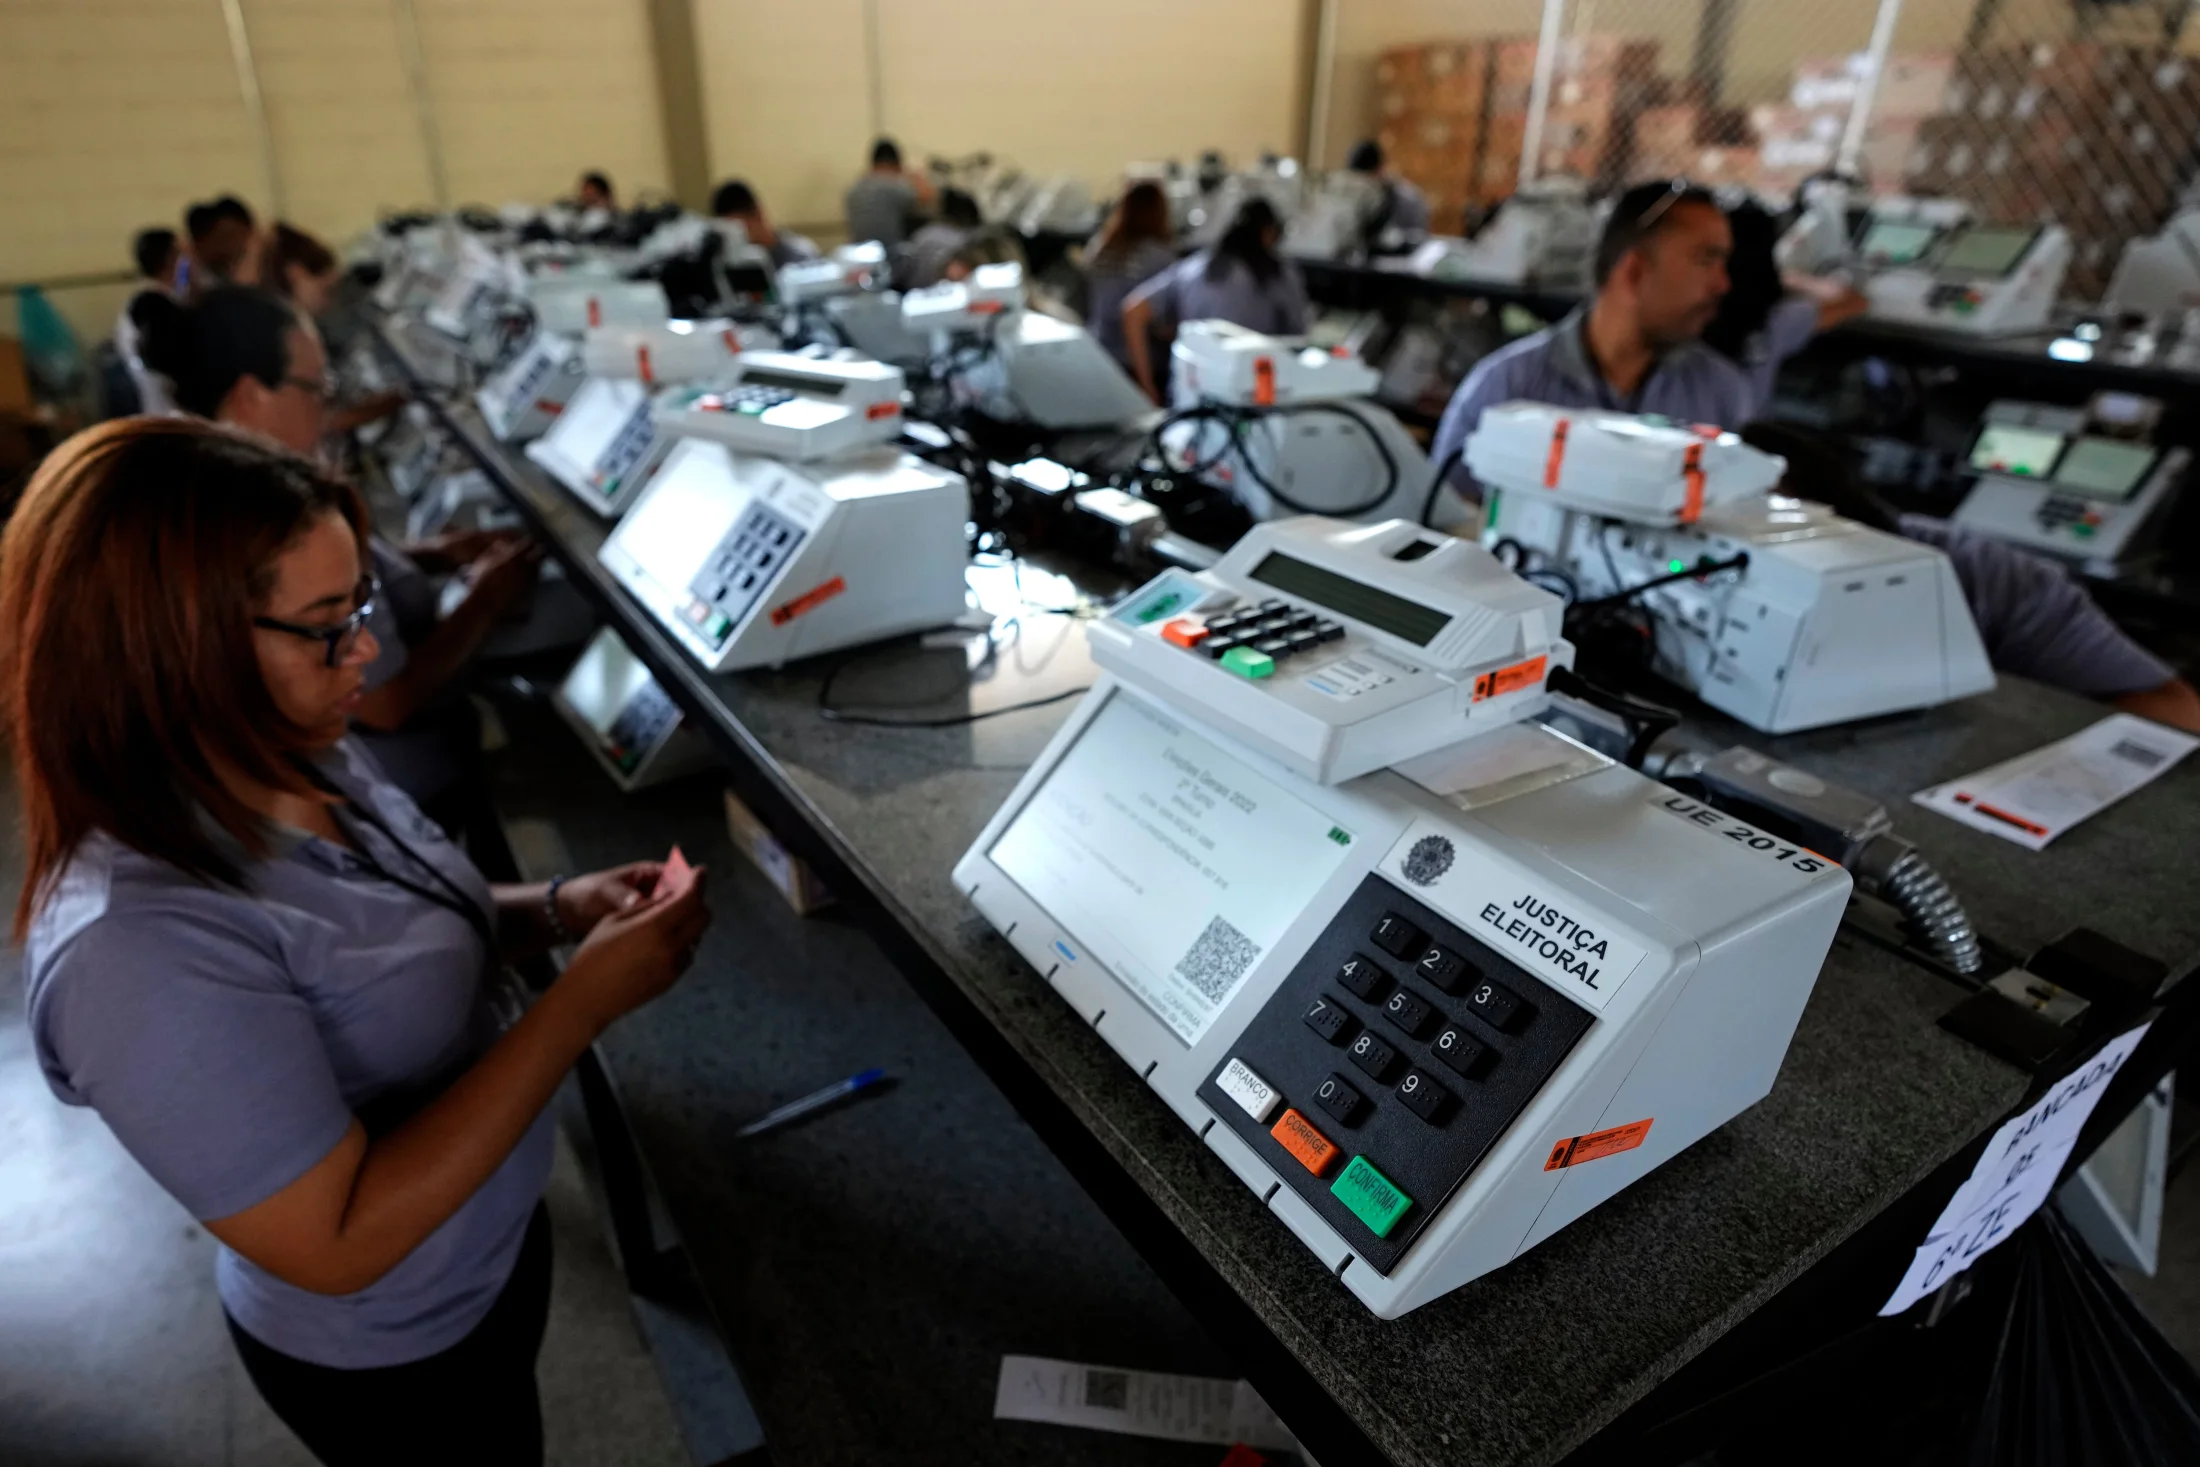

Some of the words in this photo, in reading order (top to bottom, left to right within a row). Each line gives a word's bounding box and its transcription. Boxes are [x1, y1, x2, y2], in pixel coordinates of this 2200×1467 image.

[1664, 797, 1724, 826] UE
[1723, 826, 1826, 873] 2015
[1378, 918, 1392, 934] 1
[1513, 895, 1608, 960] JUSTIÇA
[1480, 903, 1600, 991] ELEITORAL
[1342, 960, 1358, 976] 4
[1422, 949, 1441, 969] 2
[1389, 993, 1407, 1011] 5
[1474, 985, 1492, 1004] 3
[1309, 1000, 1326, 1016] 7
[1354, 1036, 1371, 1054] 8
[1438, 1030, 1456, 1049] 6
[1230, 1062, 1269, 1100] BRANCO
[1319, 1080, 1335, 1098] 0
[1401, 1074, 1419, 1093] 9
[1286, 1114, 1329, 1156] CORRIGE
[1349, 1163, 1399, 1214] CONFIRMA
[1962, 1191, 2021, 1259] ZE
